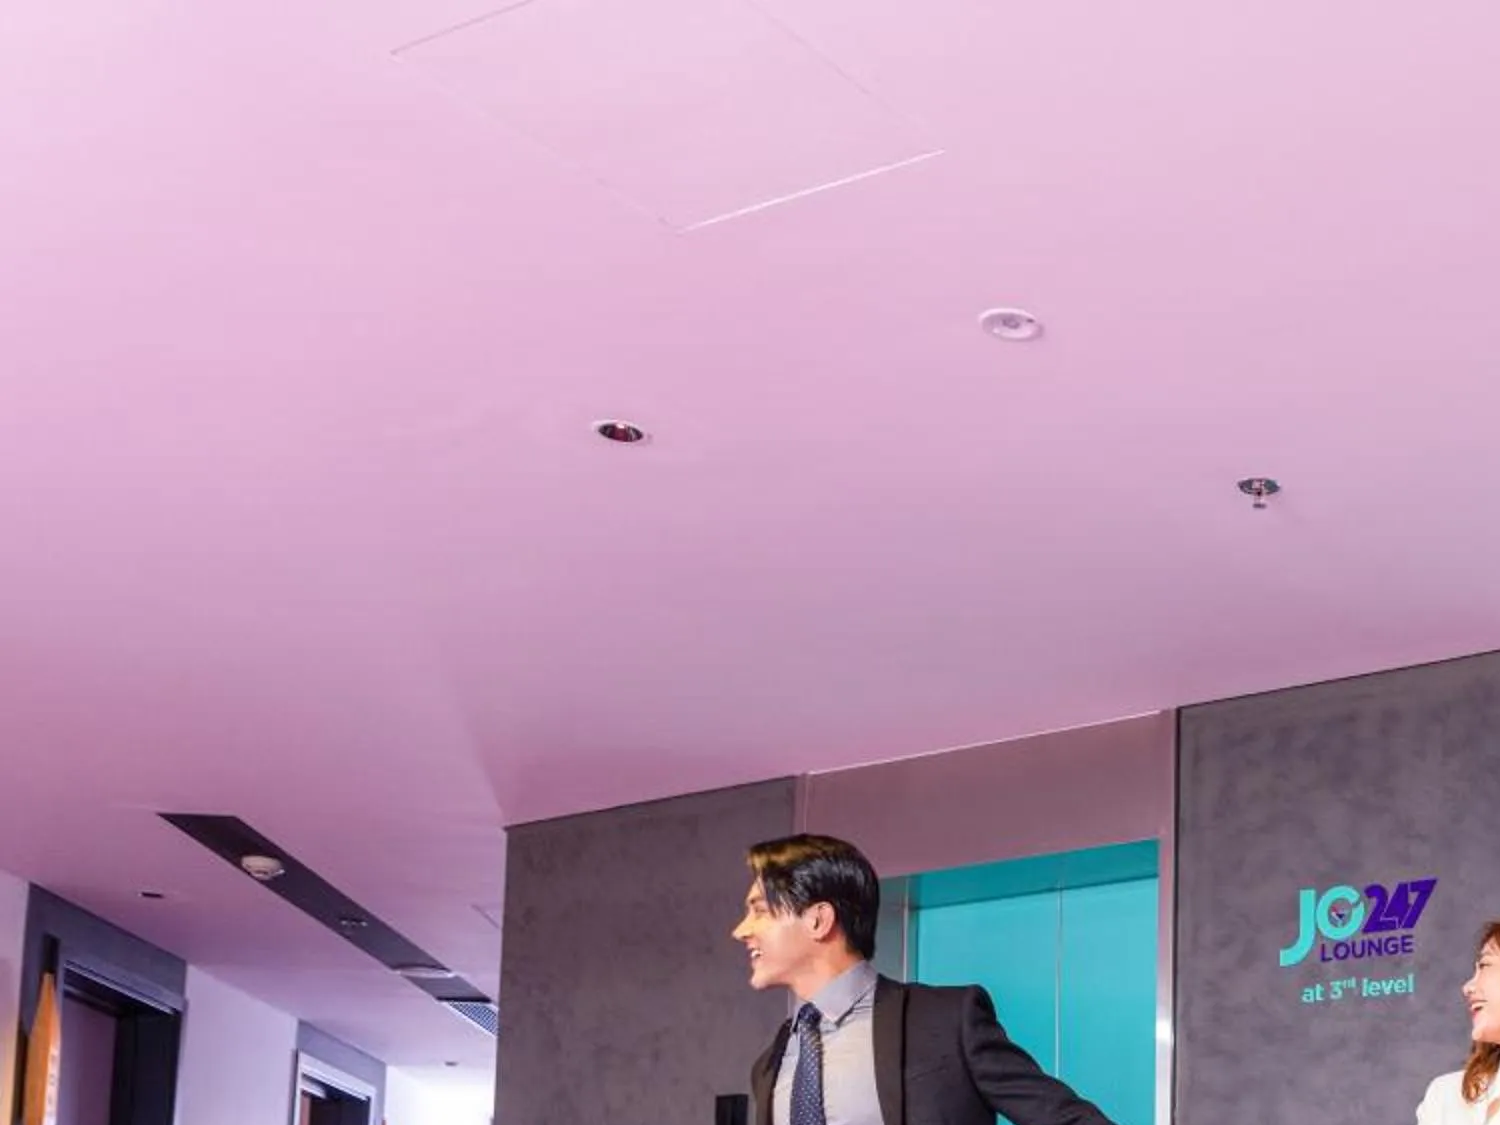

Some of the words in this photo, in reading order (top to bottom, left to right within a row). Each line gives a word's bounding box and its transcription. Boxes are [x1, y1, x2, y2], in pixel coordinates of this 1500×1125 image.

[1320, 935, 1413, 962] LOUNGE
[1301, 983, 1325, 1003] at
[1361, 972, 1414, 997] level
